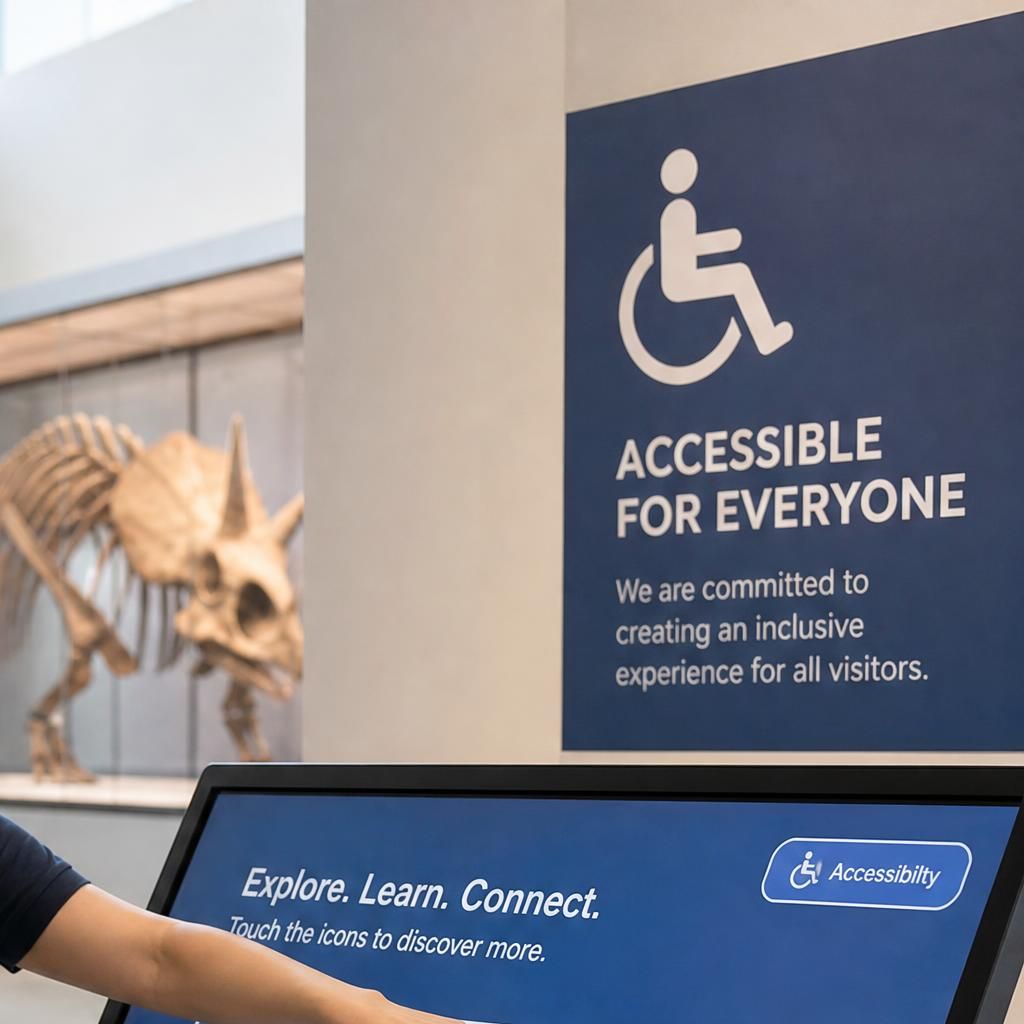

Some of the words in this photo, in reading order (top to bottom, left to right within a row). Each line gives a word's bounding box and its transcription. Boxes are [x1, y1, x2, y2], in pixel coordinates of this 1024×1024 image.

[616, 416, 882, 480] ACCESSIBLE
[617, 493, 702, 538] FOR
[716, 473, 966, 532] EVERYONE
[616, 578, 653, 603] We
[659, 580, 695, 602] are
[702, 568, 834, 601] committed
[843, 570, 869, 595] to
[616, 618, 710, 649] creating
[718, 622, 747, 641] an
[756, 613, 864, 641] inclusive
[616, 659, 743, 692] experience
[751, 656, 785, 684] for
[793, 656, 820, 683] all
[829, 655, 929, 682] visitors.
[242, 867, 349, 906] Explore.
[359, 873, 448, 910] Learn.
[460, 878, 600, 919] Connect.
[828, 862, 942, 890] Accessibilty
[230, 916, 281, 941] Touch
[284, 920, 313, 944] the
[317, 922, 368, 949] icons
[373, 928, 394, 950] to
[396, 928, 484, 957] discover
[485, 940, 547, 962] more.
